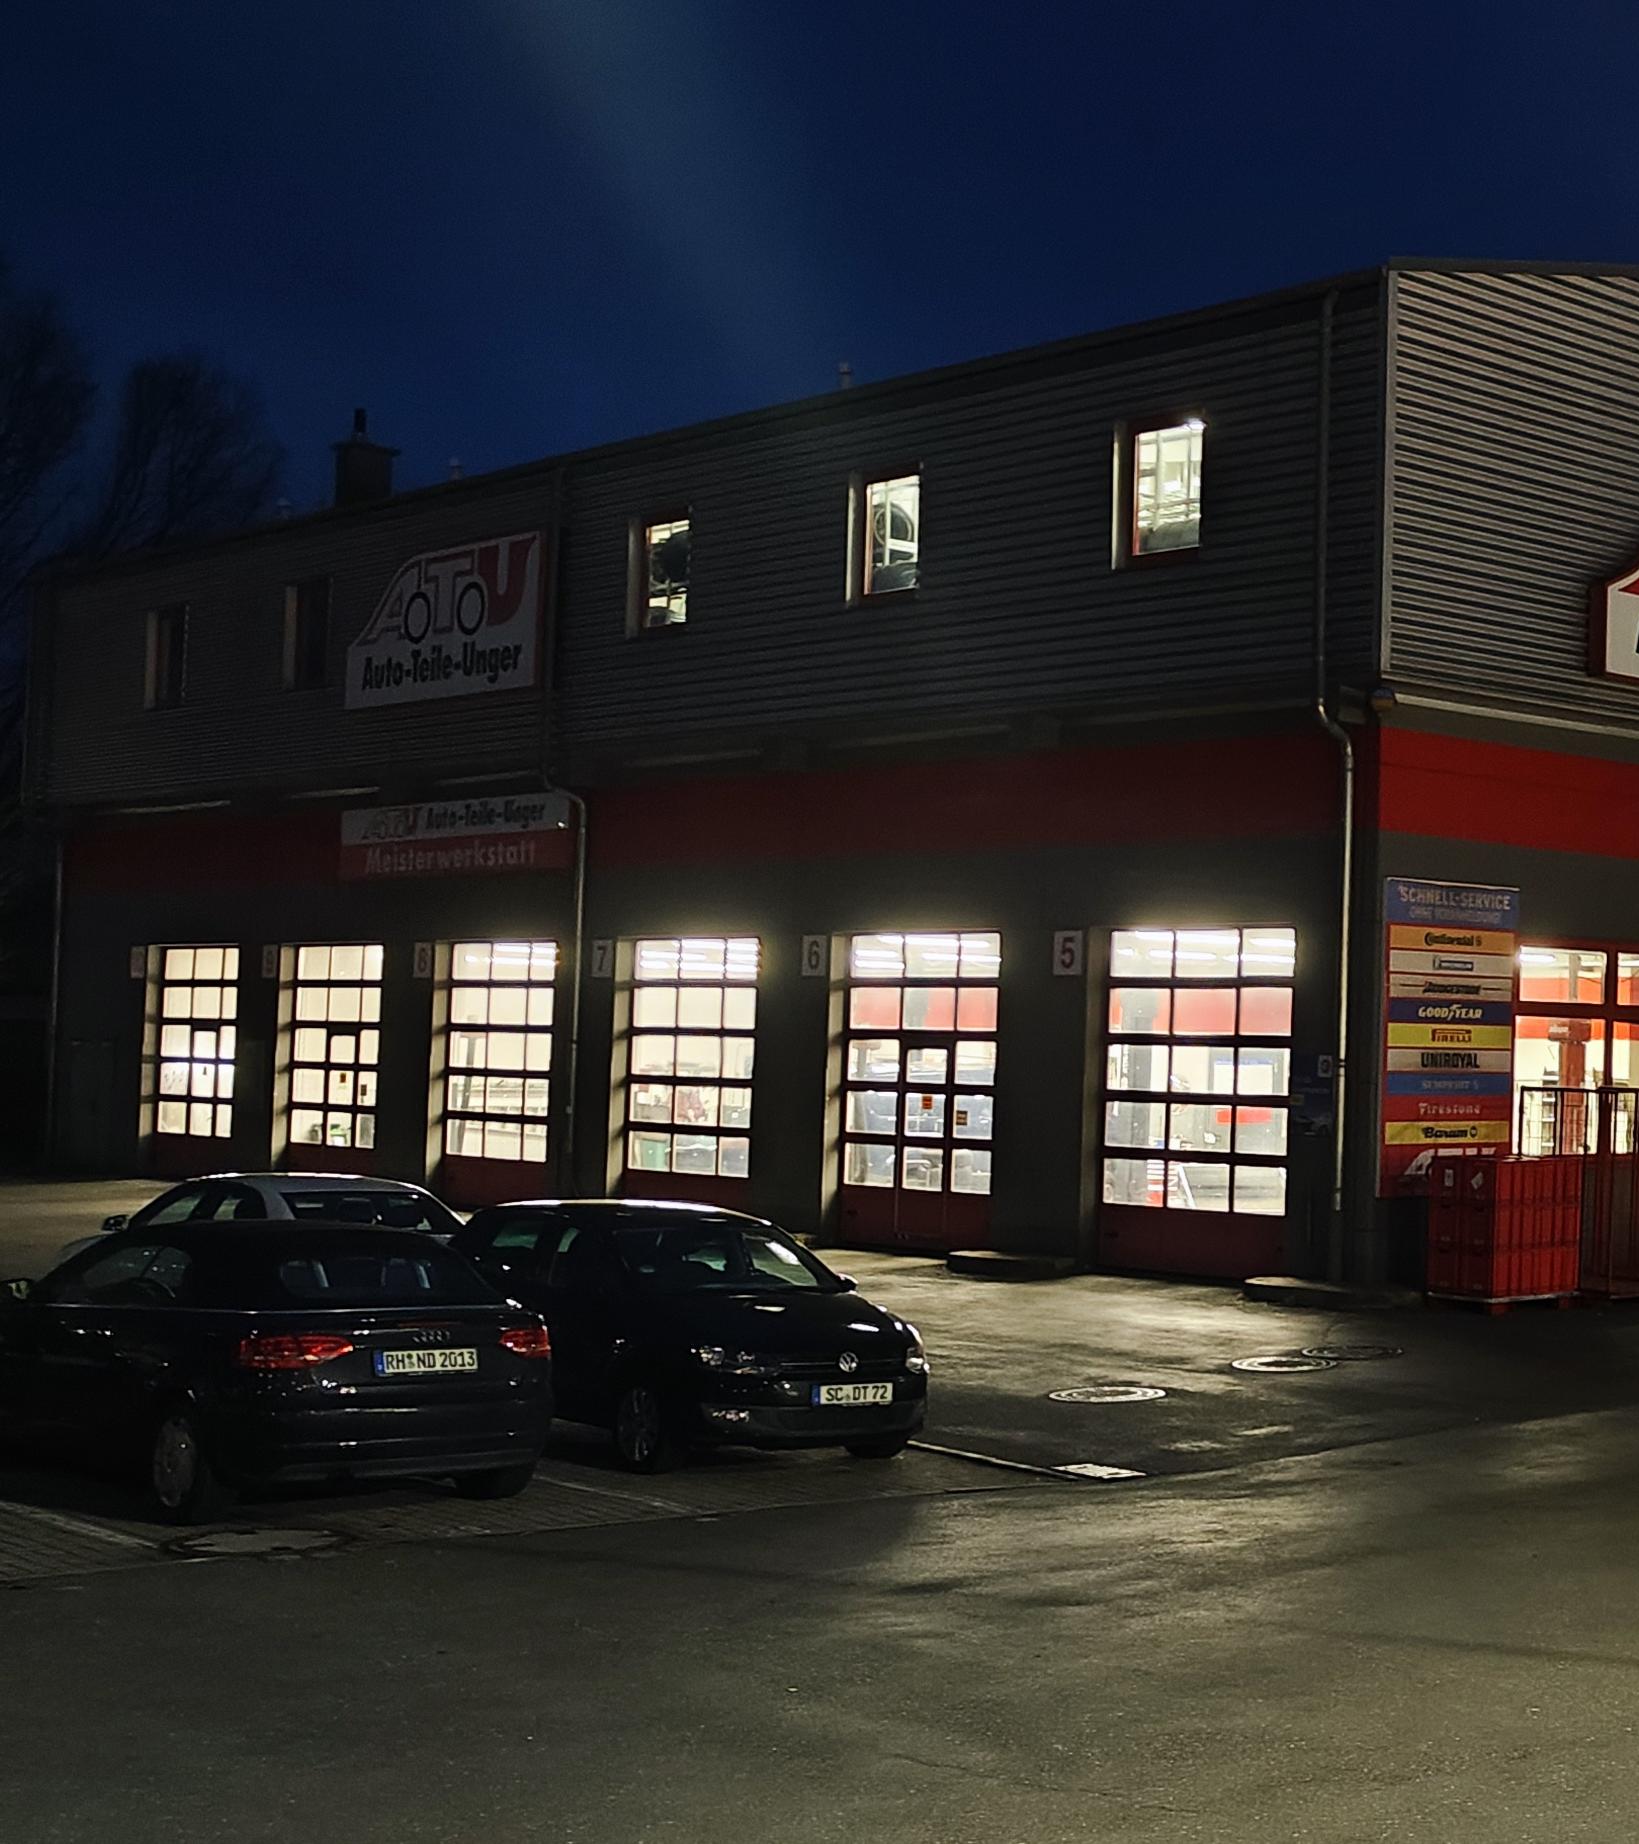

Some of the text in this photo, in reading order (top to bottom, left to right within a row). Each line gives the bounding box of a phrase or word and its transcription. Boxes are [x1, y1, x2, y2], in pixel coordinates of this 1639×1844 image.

[362, 641, 522, 690] Auto-Teile-Unger
[426, 800, 545, 829] Auto-Teile-Unger
[366, 841, 535, 874] Meisterwerkstatt
[1399, 885, 1511, 911] SCHNELL-SERVICE
[596, 947, 606, 967] 7
[808, 940, 820, 970] 6
[1061, 936, 1075, 969] 5
[1418, 1004, 1483, 1020] GOODYEAR
[1431, 1028, 1472, 1042] PIRELLI
[1421, 1052, 1480, 1069] UNIROYAL
[1418, 1102, 1481, 1115] Firestone
[386, 1351, 476, 1370] RH ND 2013
[826, 1385, 888, 1401] SC DT 72
